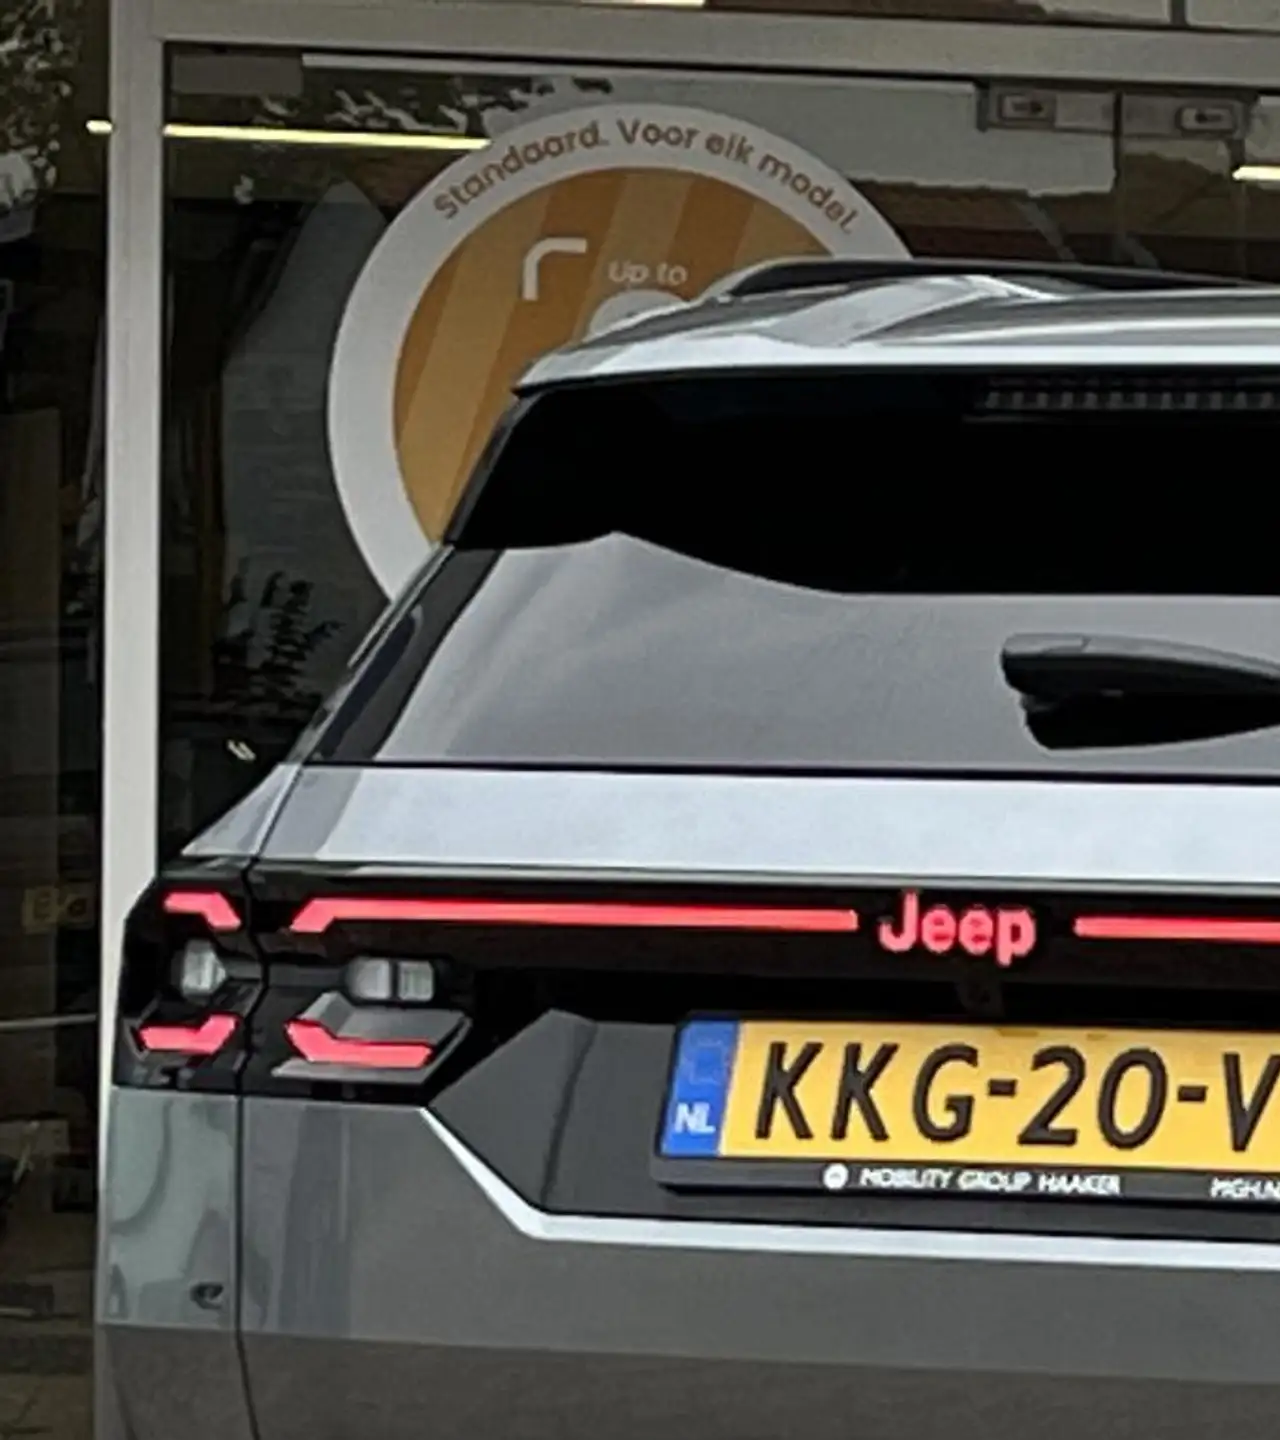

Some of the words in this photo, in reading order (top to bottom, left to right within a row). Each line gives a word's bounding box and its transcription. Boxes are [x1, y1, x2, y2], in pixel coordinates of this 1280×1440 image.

[433, 120, 609, 220] Standaard.
[616, 117, 700, 149] Voor
[704, 132, 755, 165] elk
[608, 260, 649, 286] Up
[656, 262, 689, 285] to
[878, 887, 1037, 968] Jeep
[675, 1103, 716, 1135] NL
[860, 1167, 953, 1190] MOBILITY
[957, 1169, 1033, 1193] GROUP
[1038, 1172, 1121, 1196] HAAKER
